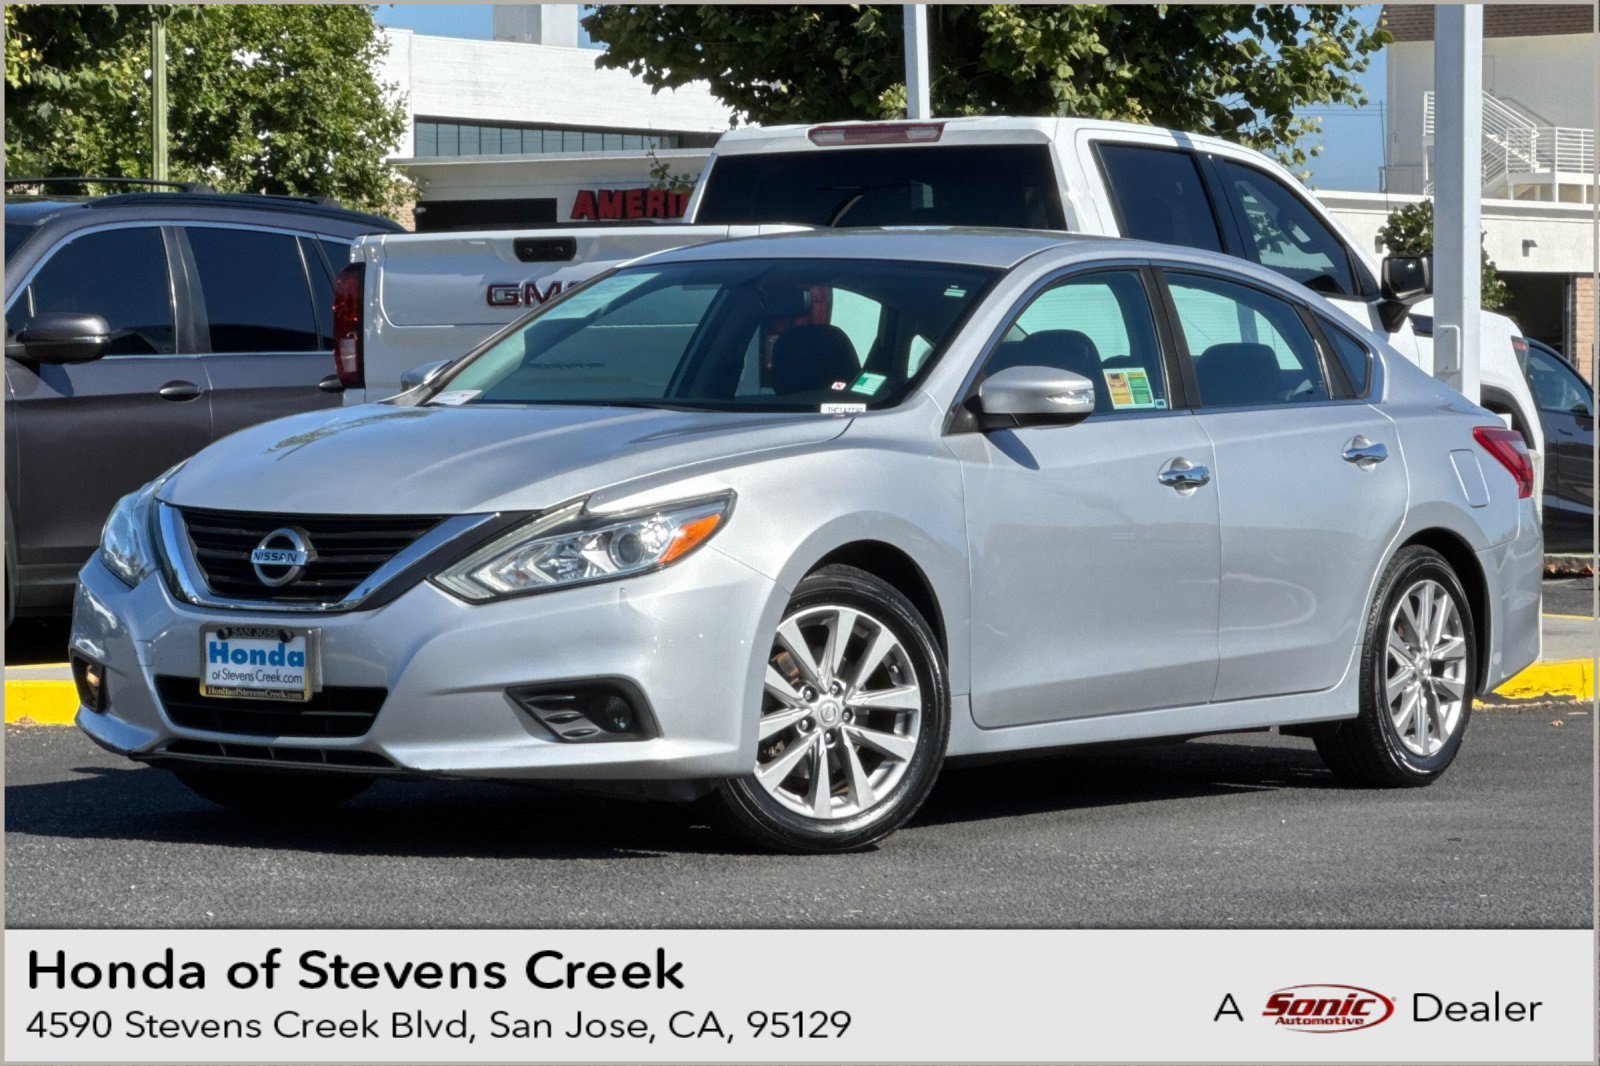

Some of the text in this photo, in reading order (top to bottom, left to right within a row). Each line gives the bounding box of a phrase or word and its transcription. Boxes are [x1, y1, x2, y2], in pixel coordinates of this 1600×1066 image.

[486, 280, 580, 307] GM
[253, 551, 298, 562] NISSAN
[231, 627, 251, 638] SAN
[208, 641, 304, 667] Honda
